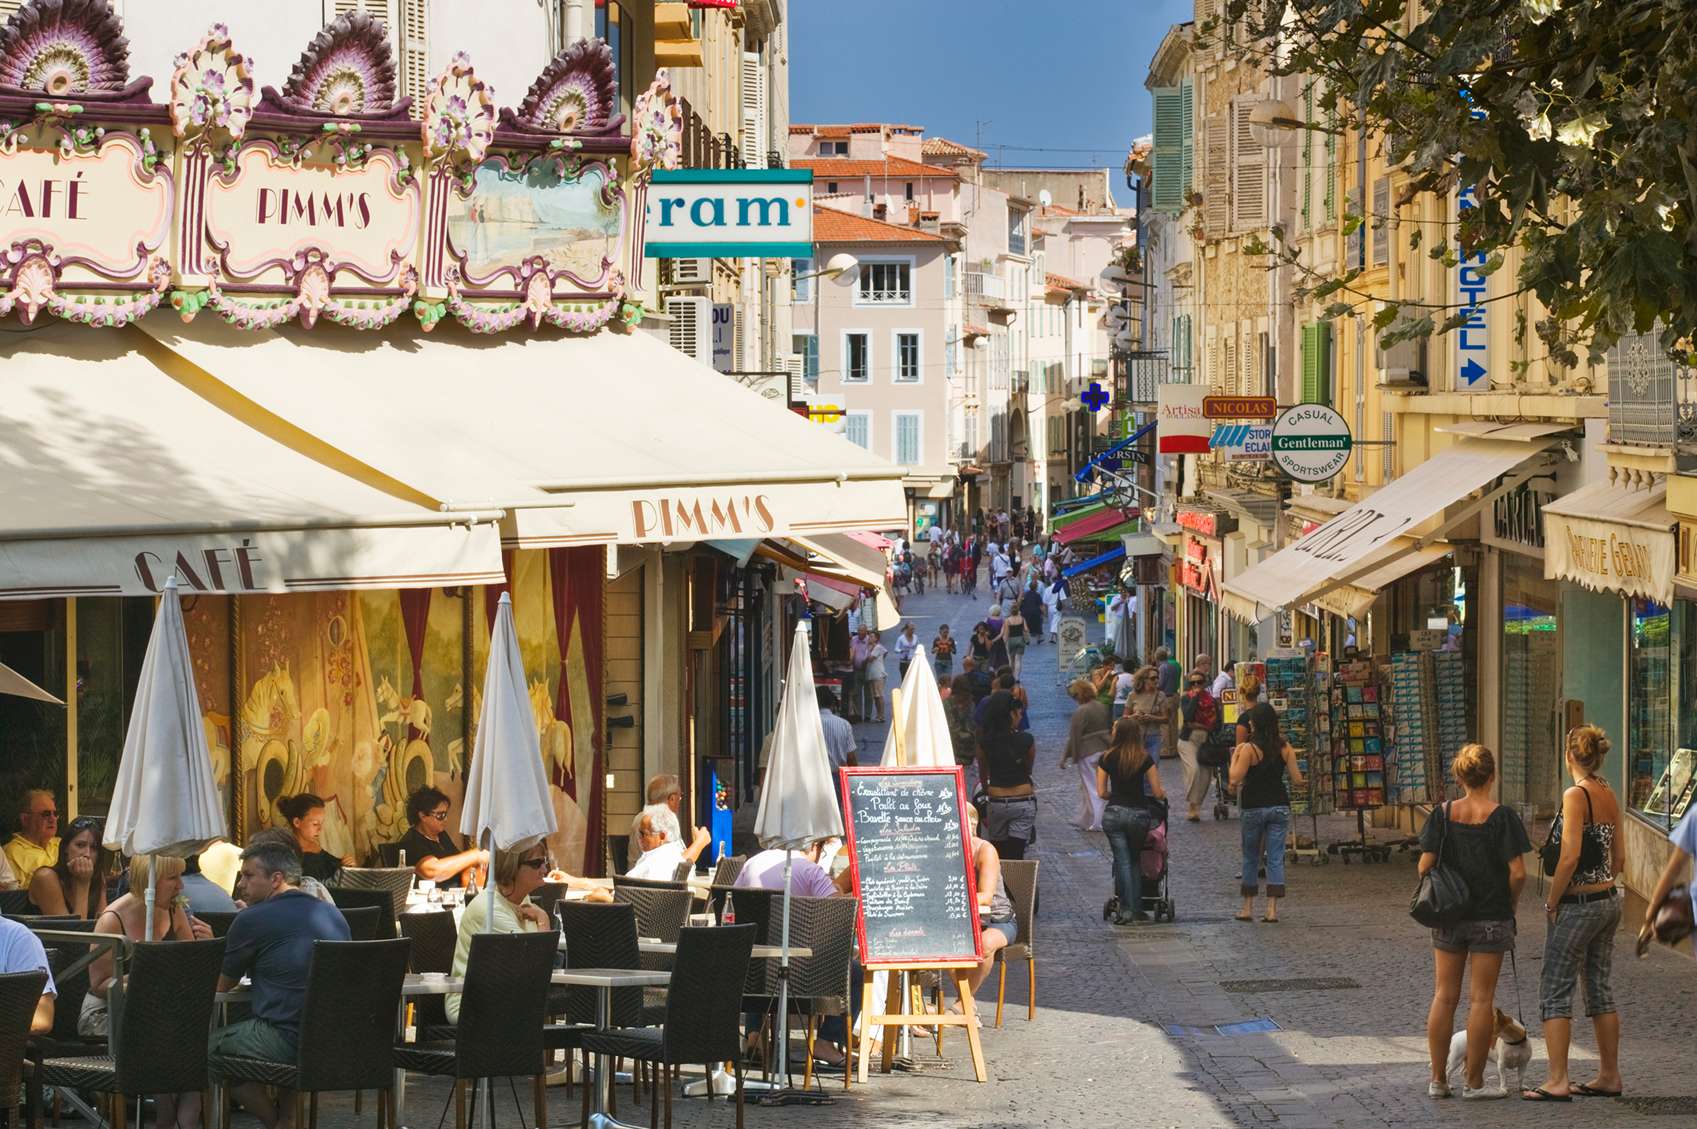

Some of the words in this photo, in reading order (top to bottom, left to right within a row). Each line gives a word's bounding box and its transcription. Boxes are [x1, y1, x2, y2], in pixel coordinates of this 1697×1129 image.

[0, 171, 88, 220] AFÉ
[256, 187, 371, 230] PIMM'S
[646, 197, 791, 227] ram
[1162, 404, 1201, 415] Artisa
[1212, 402, 1268, 414] NICOLAS
[1288, 410, 1333, 426] CASUAL
[1249, 429, 1271, 440] STOR
[1245, 442, 1271, 453] ECLAI
[1282, 452, 1345, 476] SPORTSWEAR
[631, 494, 774, 538] PIMM'S
[134, 539, 269, 593] CAFÉ
[857, 810, 891, 824] Bavette
